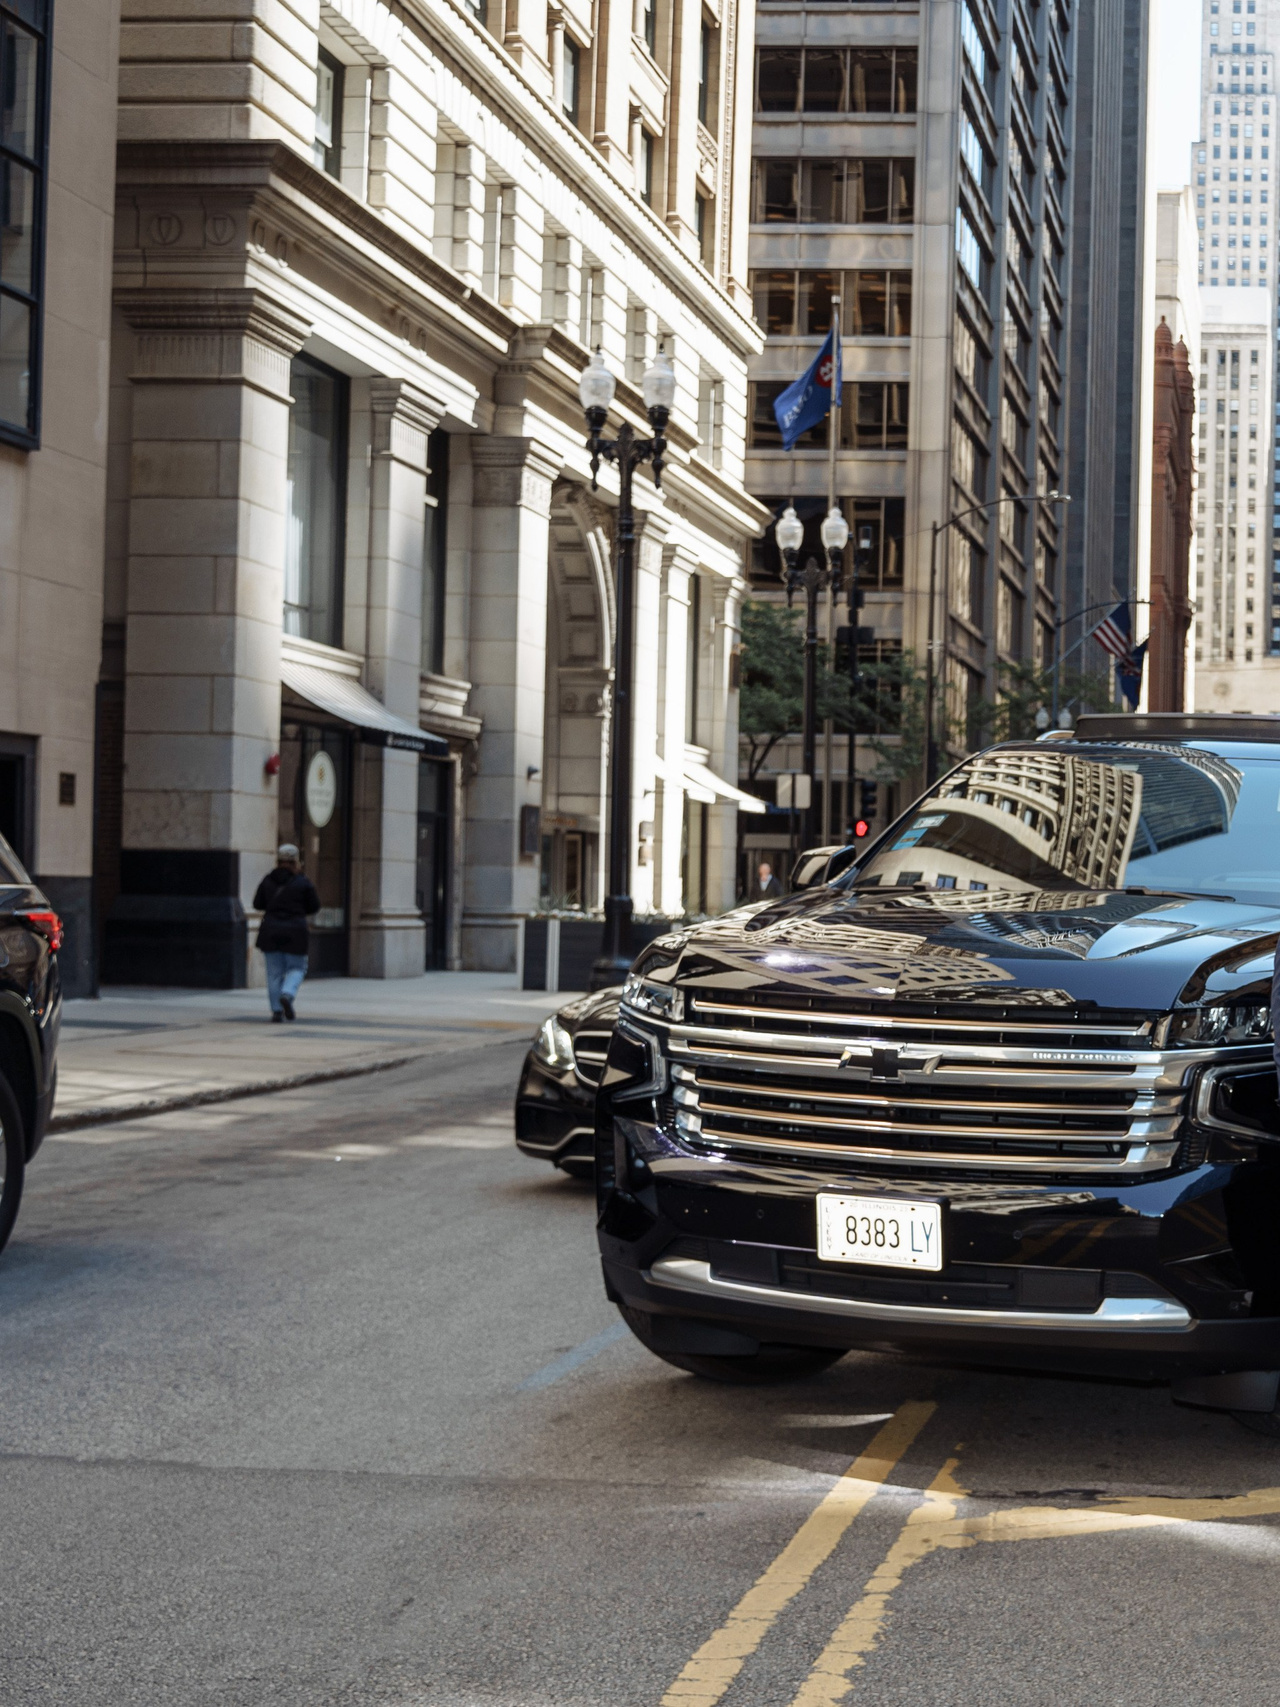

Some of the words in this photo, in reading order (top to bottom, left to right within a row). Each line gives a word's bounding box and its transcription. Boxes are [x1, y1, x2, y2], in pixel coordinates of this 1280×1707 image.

[861, 1203, 896, 1212] ILLINOIS
[846, 1215, 900, 1248] 8383
[911, 1221, 933, 1253] LY
